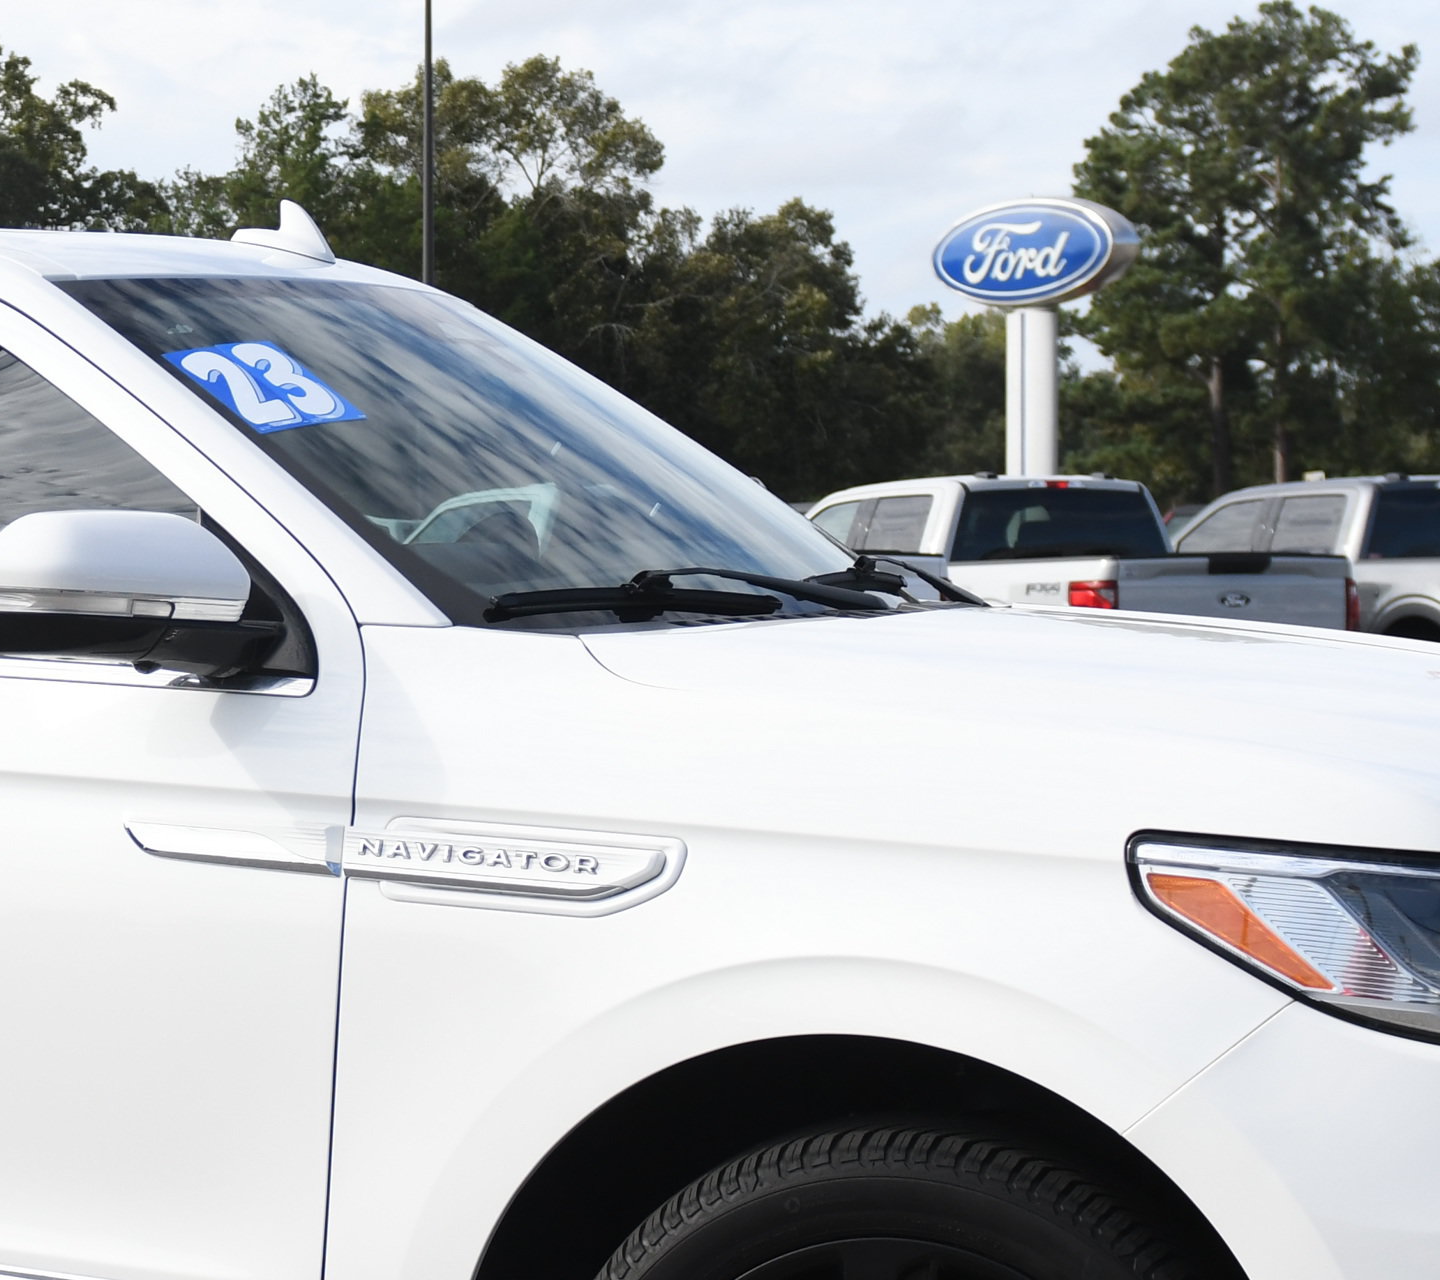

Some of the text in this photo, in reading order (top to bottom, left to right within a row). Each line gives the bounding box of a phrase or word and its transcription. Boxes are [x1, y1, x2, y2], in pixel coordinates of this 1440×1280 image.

[963, 221, 1070, 285] Ford
[181, 342, 346, 427] 23
[358, 837, 601, 875] NAVIGATOR
